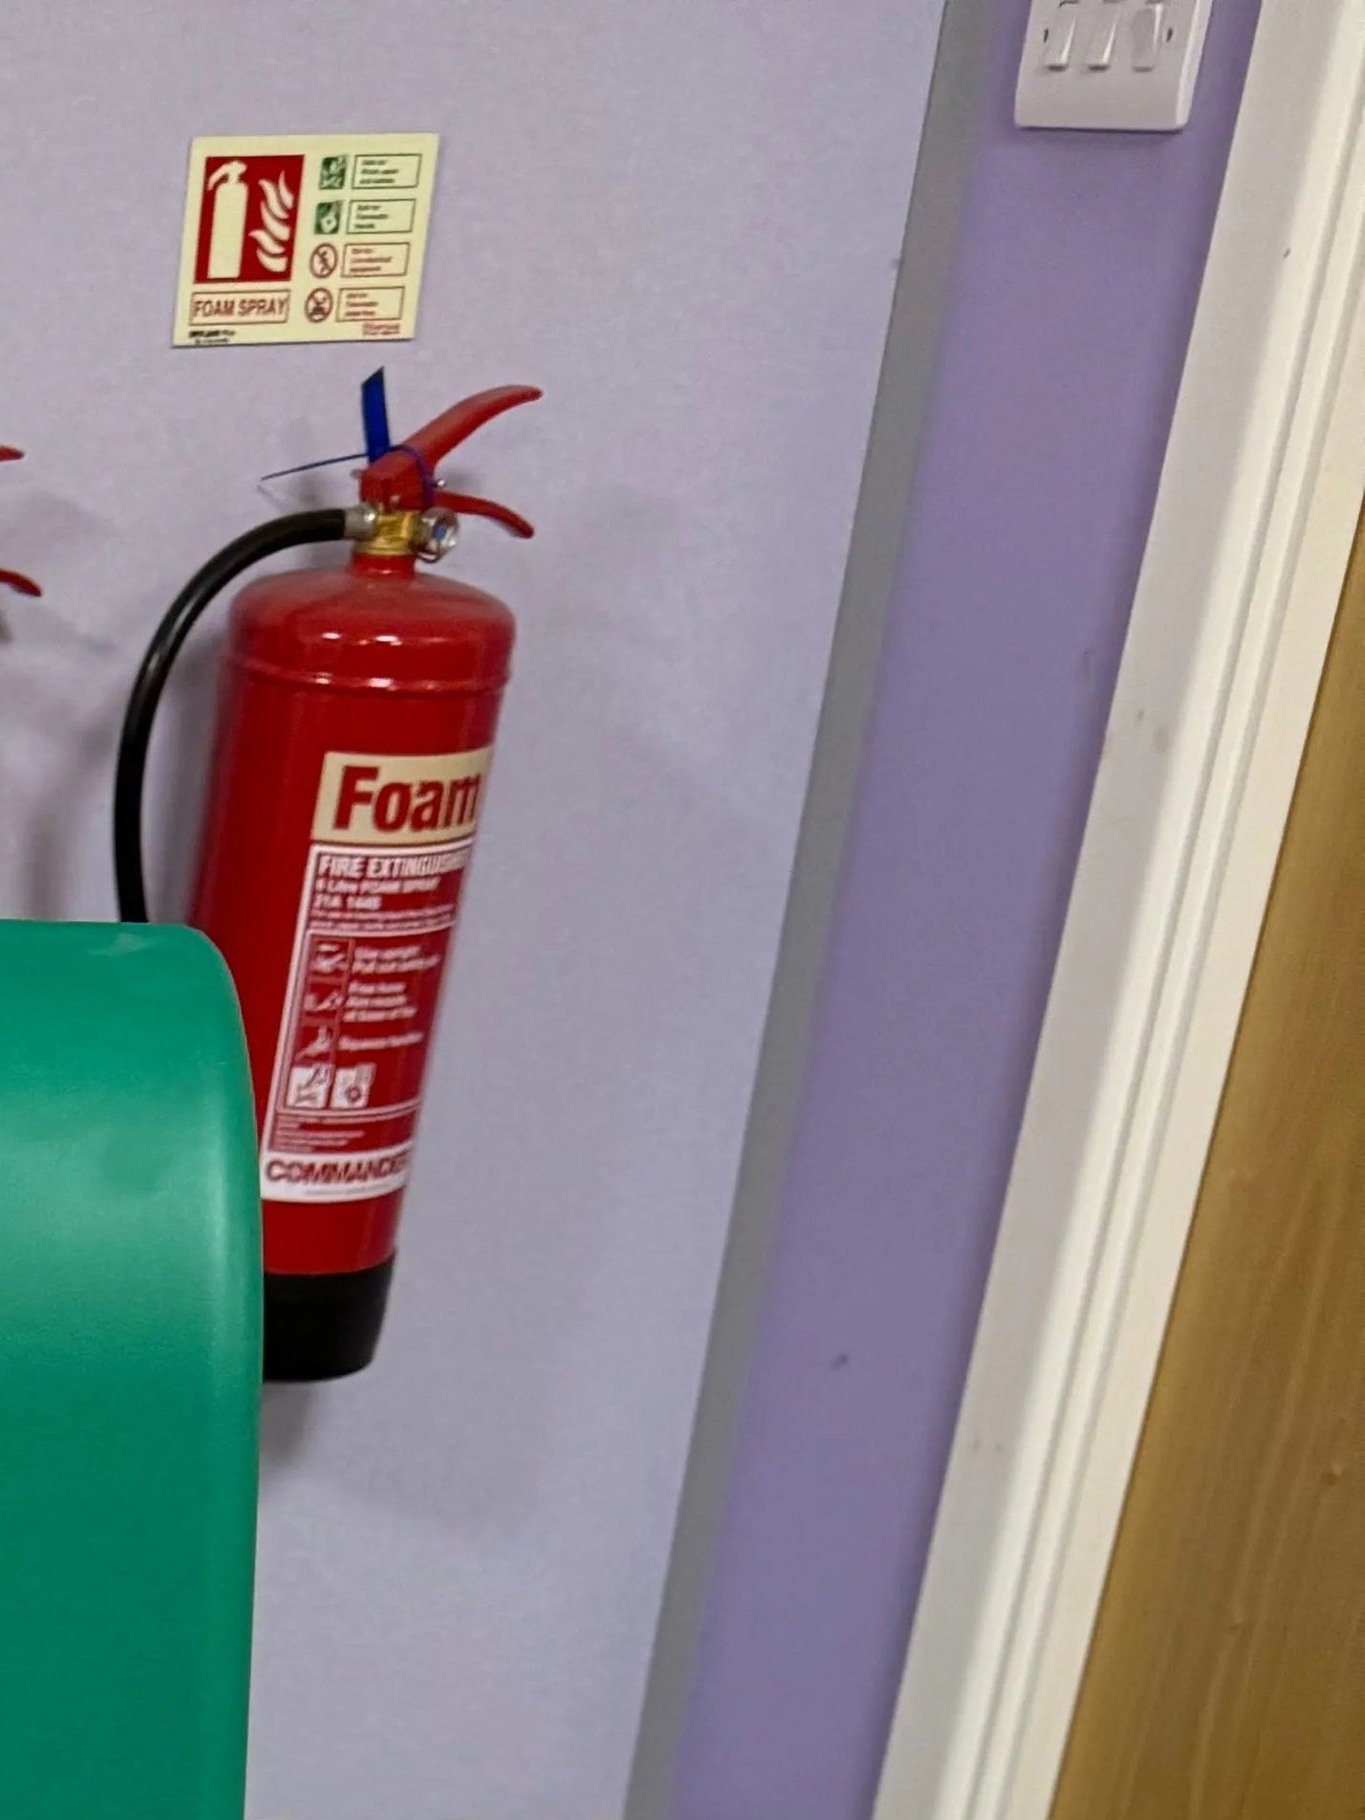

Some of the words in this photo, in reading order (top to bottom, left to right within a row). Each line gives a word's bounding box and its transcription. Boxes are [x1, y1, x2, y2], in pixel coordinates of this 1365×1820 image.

[193, 299, 235, 317] FOAM
[237, 298, 287, 316] SPRAY
[332, 764, 481, 833] Foam
[318, 855, 366, 878] FIRE
